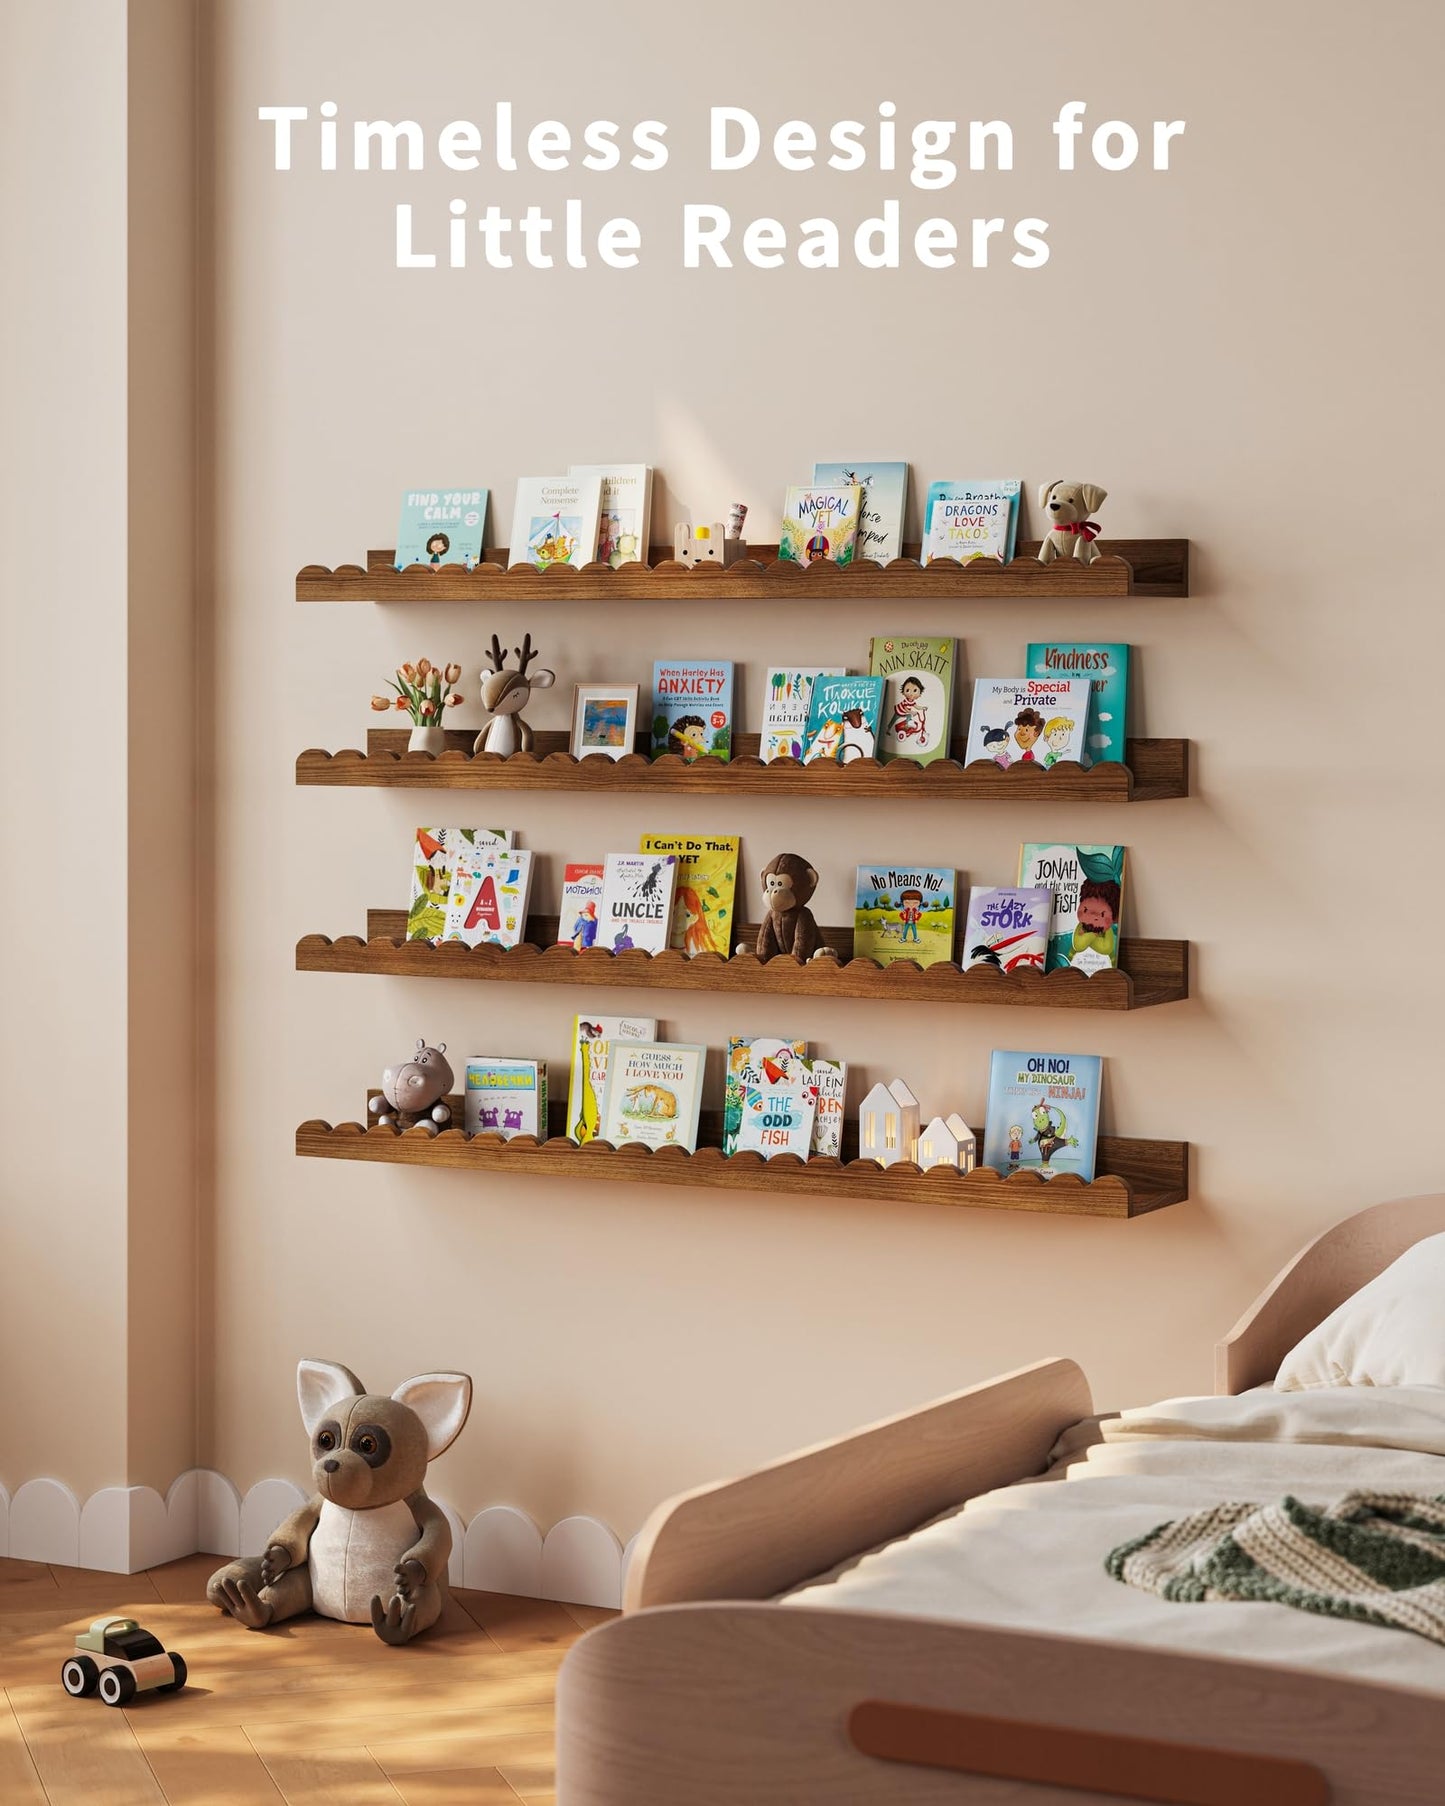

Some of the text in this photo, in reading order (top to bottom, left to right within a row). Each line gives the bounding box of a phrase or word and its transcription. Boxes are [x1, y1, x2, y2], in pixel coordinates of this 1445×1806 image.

[542, 487, 579, 497] Complete
[408, 492, 481, 507] FIND YOUR
[540, 497, 579, 505] Nonsense
[424, 507, 461, 520] CALM
[799, 496, 849, 519] MAGICAL
[945, 505, 999, 517] DRAGONS
[810, 510, 834, 528] YET
[954, 517, 985, 528] LOVE
[857, 529, 889, 546] mped
[949, 528, 990, 540] TACOS
[879, 651, 950, 677] MIN SKATT
[1045, 648, 1109, 671] Kindness
[660, 668, 725, 678] When Harley Has
[659, 678, 726, 694] ANXIETY
[992, 687, 1003, 695] My
[1004, 686, 1020, 694] Body
[1027, 681, 1071, 695] Special
[1014, 694, 1057, 706] Private
[646, 840, 651, 849] I
[654, 840, 683, 850] Can't
[686, 841, 702, 851] Do
[678, 855, 700, 864] YET
[1035, 858, 1078, 881] JONAH
[871, 871, 944, 892] No Means No!
[1035, 880, 1079, 894] and the very
[612, 902, 665, 919] UNCLE
[987, 898, 1027, 912] THE LAZY
[981, 909, 1033, 930] STORK
[641, 1053, 672, 1062] GUESS
[629, 1060, 683, 1071] HOW MUCH
[1027, 1058, 1070, 1074] OH NO!
[625, 1069, 684, 1081] I LOVE YOU
[802, 1074, 821, 1087] LASS
[1017, 1073, 1075, 1086] MY DINOSAUR
[768, 1097, 793, 1113] THE
[819, 1097, 843, 1114] BEN
[763, 1114, 793, 1128] ODD
[761, 1130, 790, 1146] FISH
